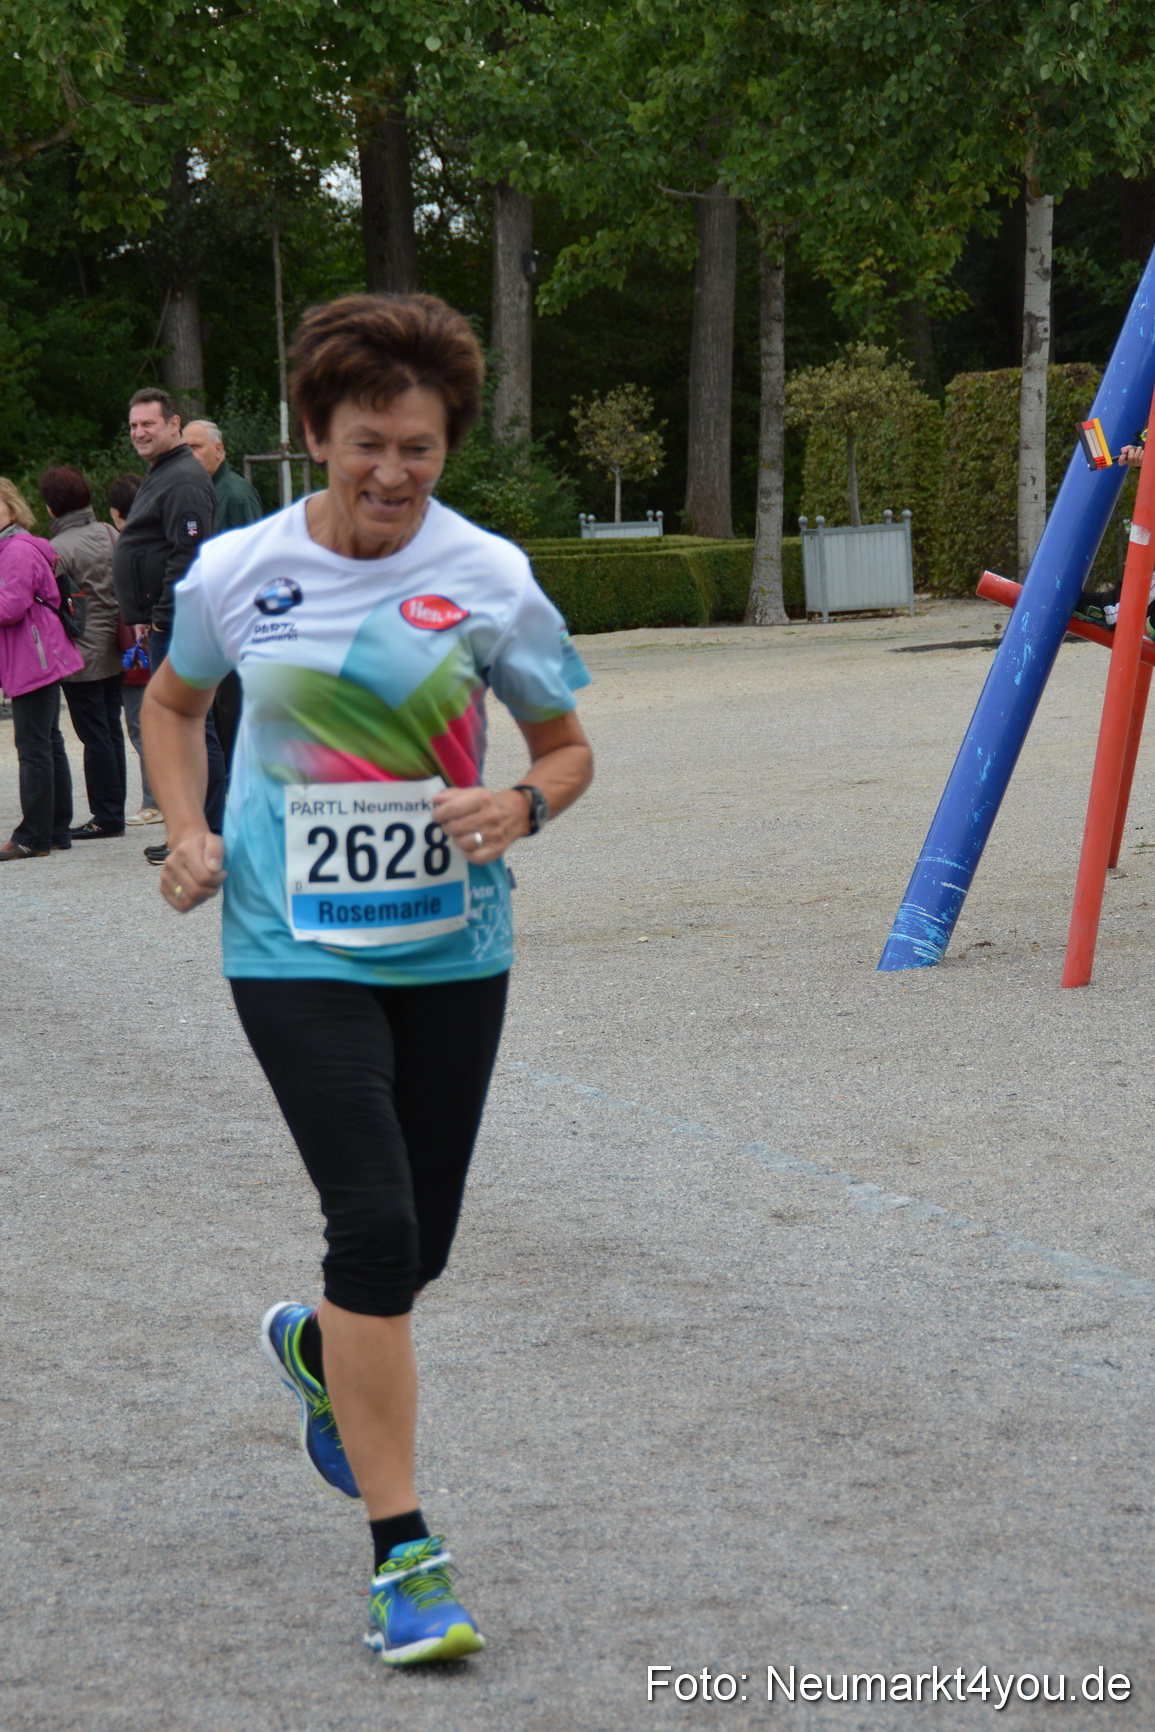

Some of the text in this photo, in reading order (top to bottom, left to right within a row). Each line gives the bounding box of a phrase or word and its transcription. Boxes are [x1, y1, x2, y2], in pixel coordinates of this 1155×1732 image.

[290, 800, 348, 816] PARTL
[307, 821, 452, 884] 2628
[318, 894, 442, 924] Rosemarie
